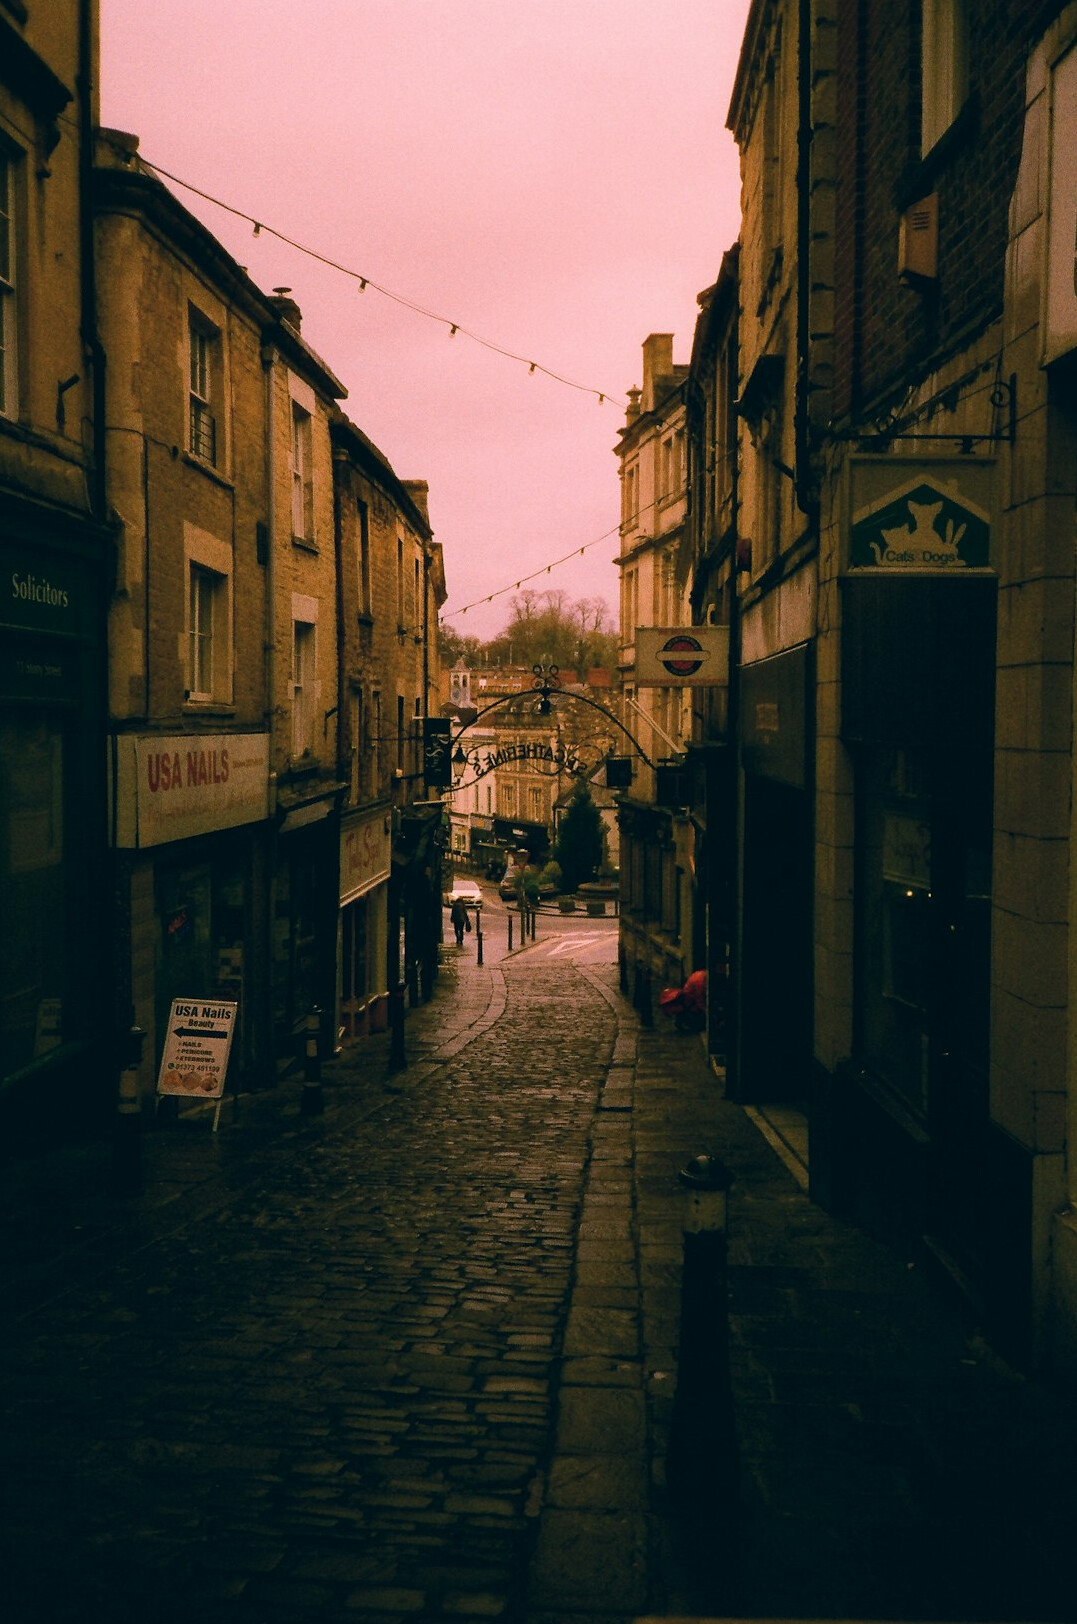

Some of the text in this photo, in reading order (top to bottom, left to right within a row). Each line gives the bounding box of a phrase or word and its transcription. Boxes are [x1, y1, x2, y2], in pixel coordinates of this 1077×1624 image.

[886, 550, 915, 562] Cats
[923, 550, 956, 565] Dogs
[12, 573, 69, 608] Solicitors
[147, 749, 229, 792] USA NAILS
[175, 1005, 232, 1019] USA Nails
[188, 1019, 215, 1028] Beauty
